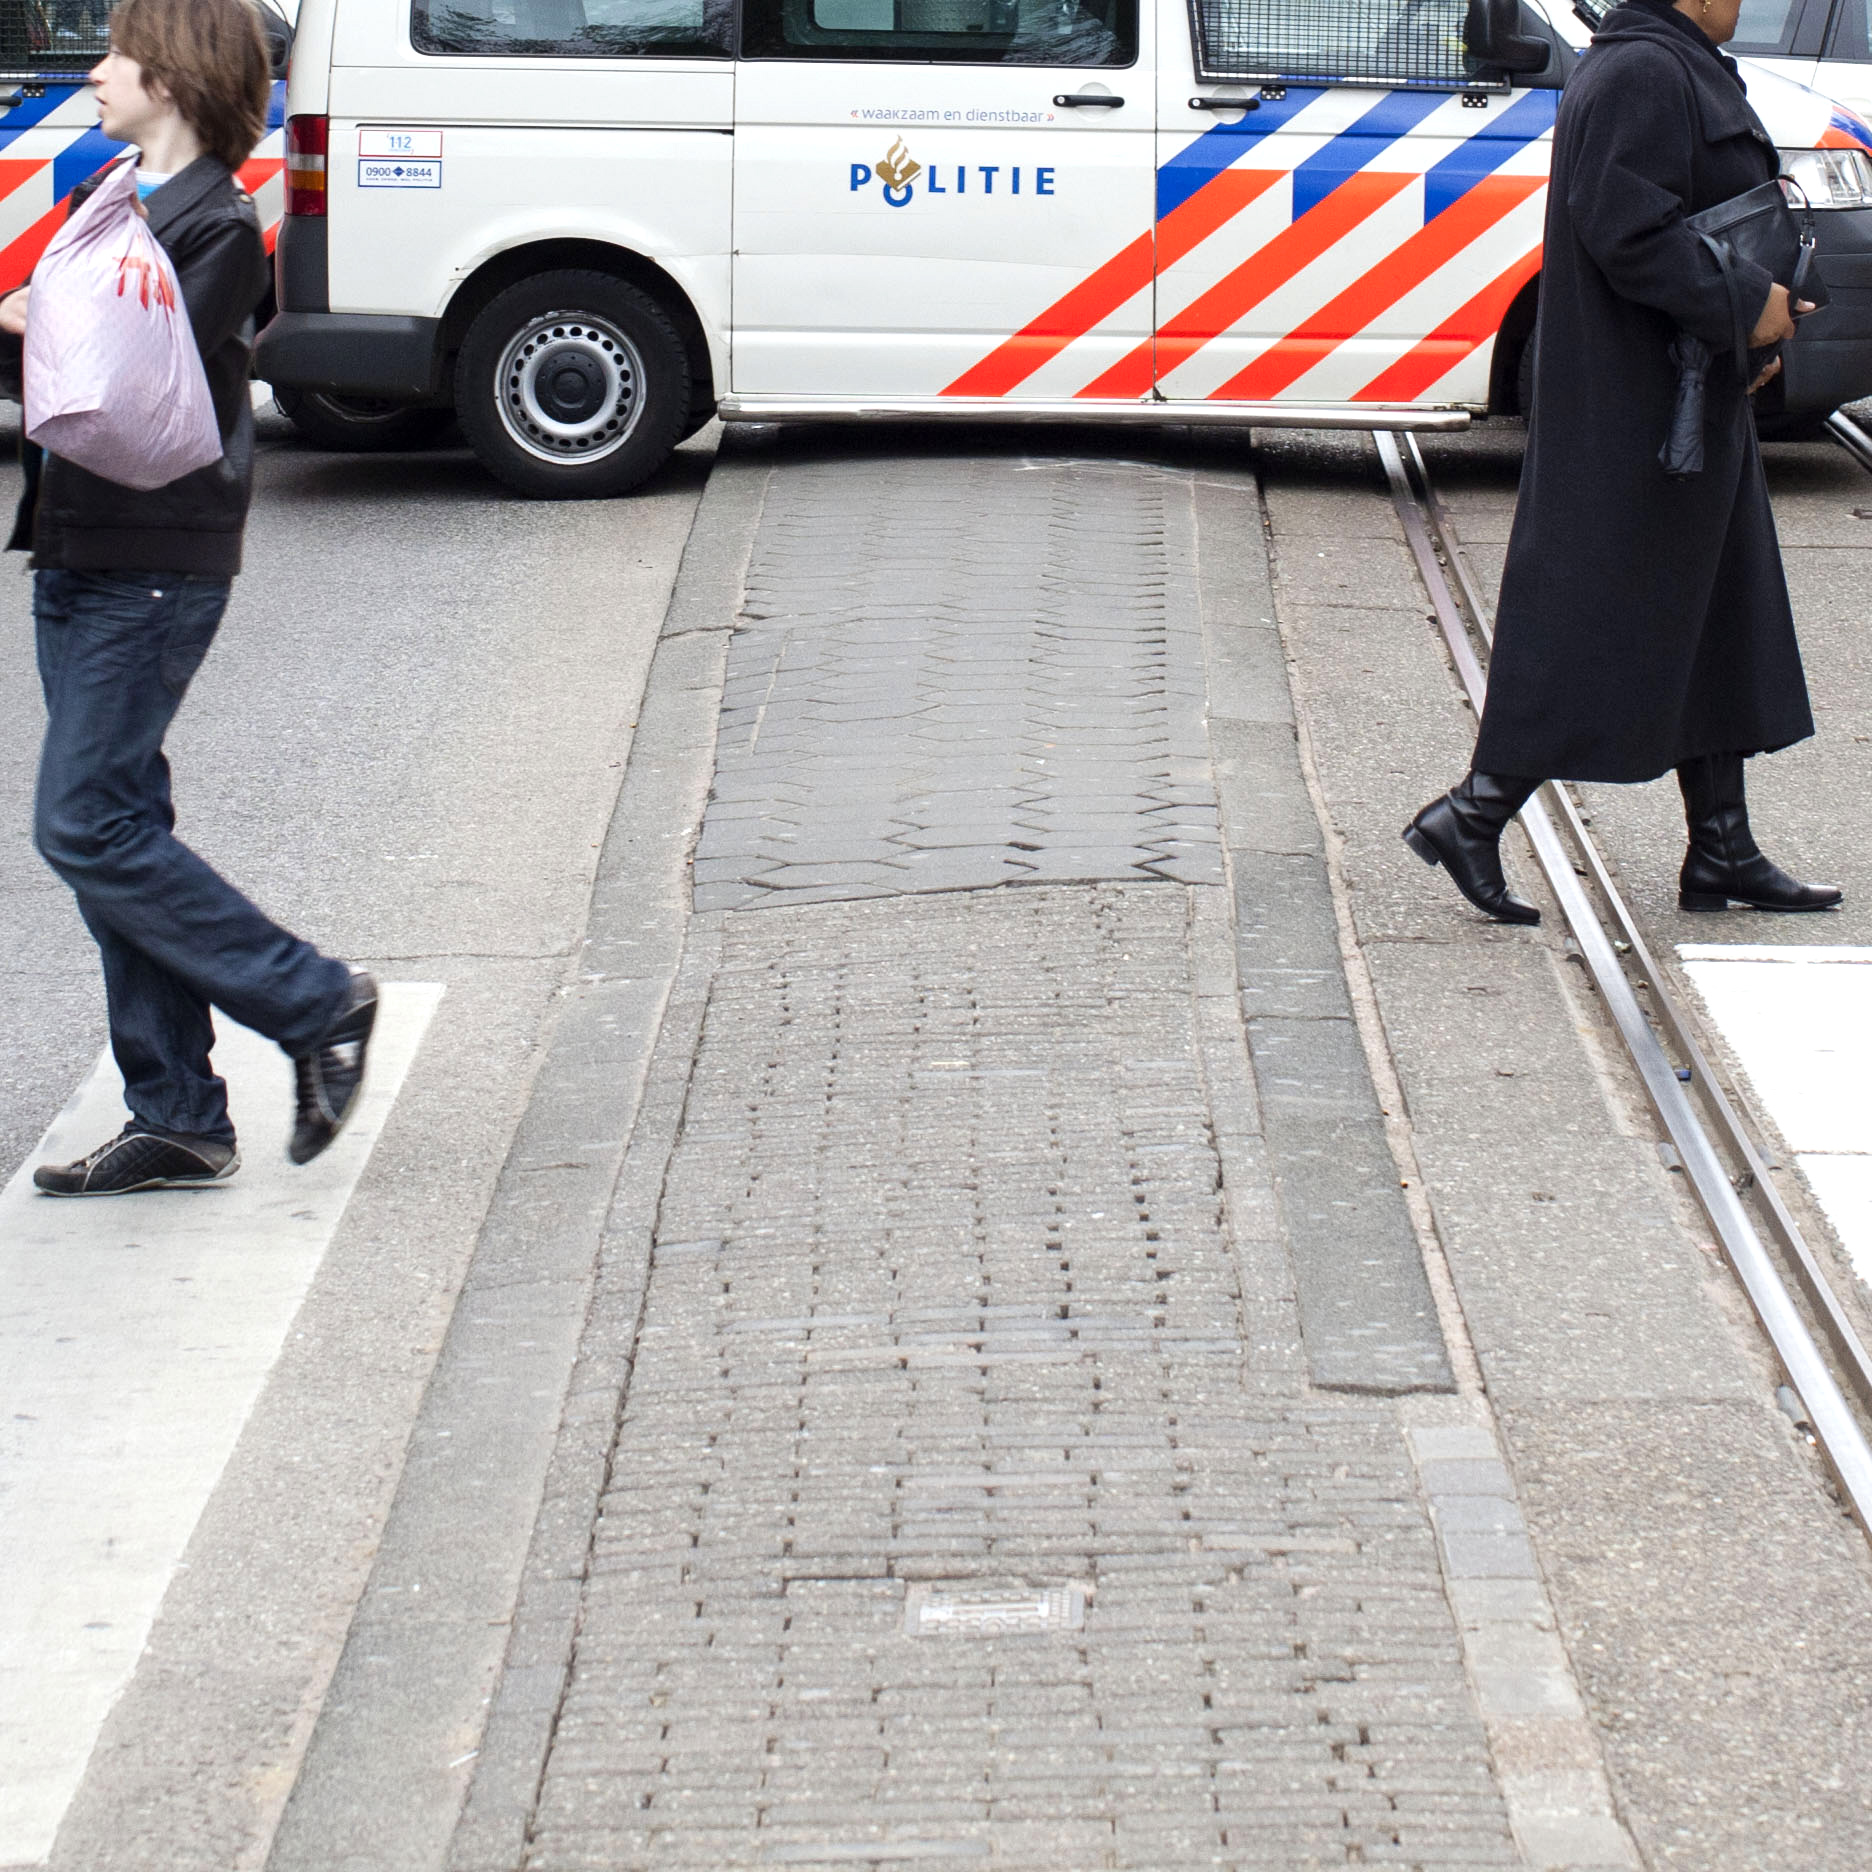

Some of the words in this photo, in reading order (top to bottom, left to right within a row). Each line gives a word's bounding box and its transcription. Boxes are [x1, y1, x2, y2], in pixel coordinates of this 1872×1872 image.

[861, 108, 940, 121] waakzaam
[943, 110, 962, 121] en
[965, 108, 1044, 123] dienstbaar
[389, 135, 413, 149] 112
[365, 167, 391, 177] 0900
[405, 167, 432, 177] 8844
[849, 163, 1056, 208] POLITIE
